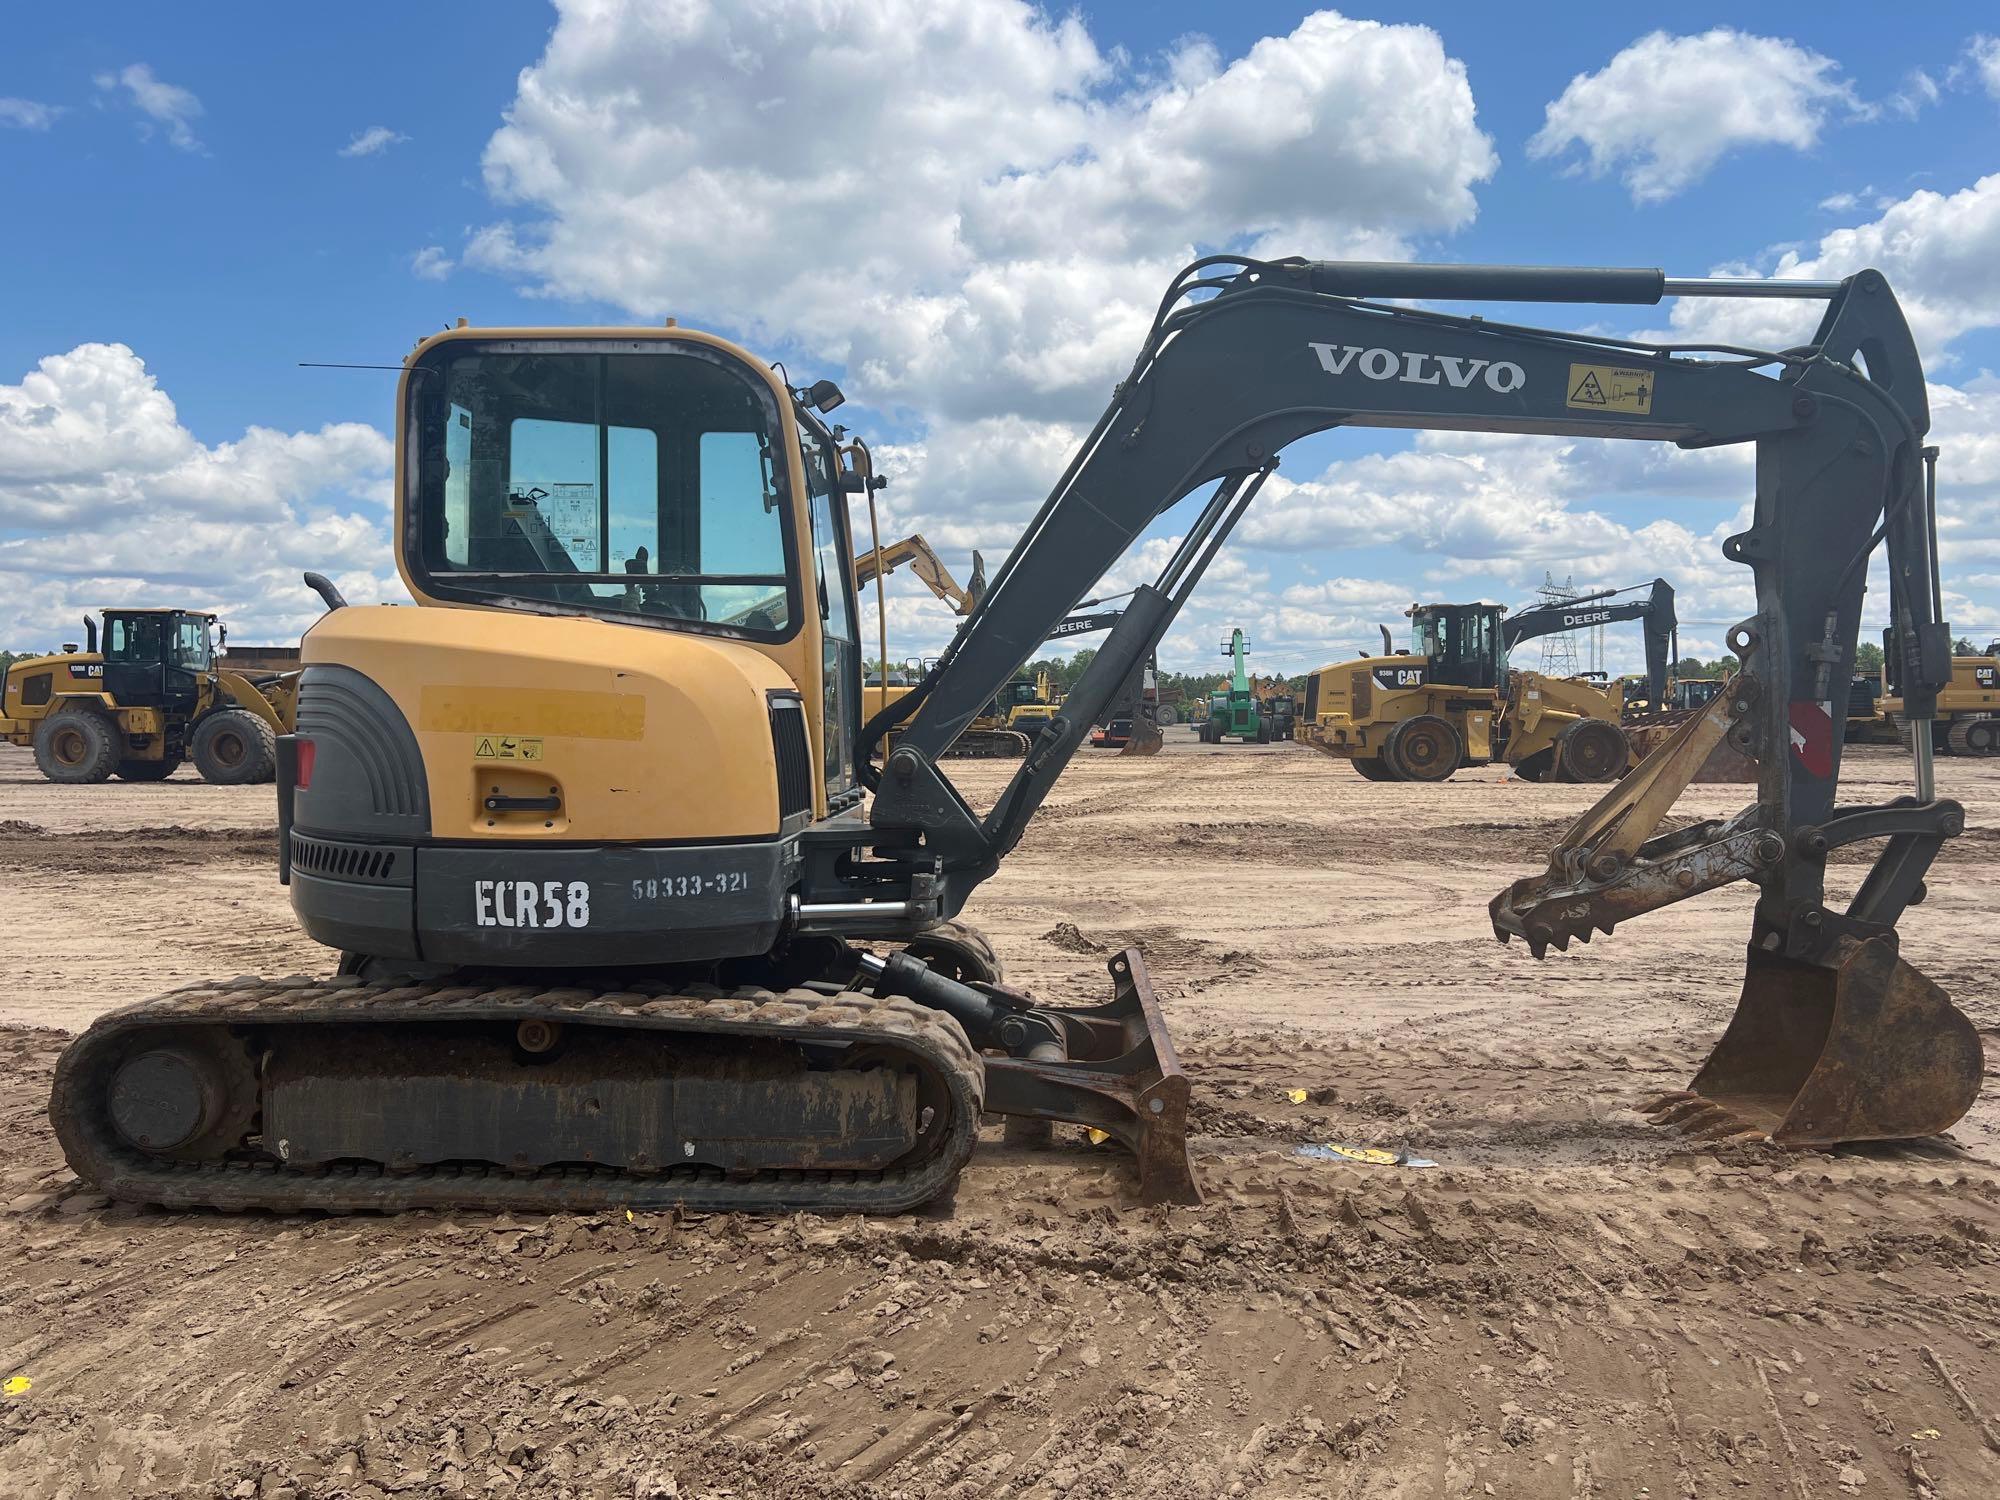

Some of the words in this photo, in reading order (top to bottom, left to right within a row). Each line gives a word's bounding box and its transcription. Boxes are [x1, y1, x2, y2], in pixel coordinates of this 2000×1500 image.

[1308, 342, 1526, 394] VOLVO
[1563, 611, 1611, 626] DEERE
[88, 665, 104, 677] CAT
[1397, 669, 1423, 686] CAT
[1976, 668, 1993, 679] CAT
[632, 871, 748, 900] 58333-321
[475, 880, 590, 928] ECR58
